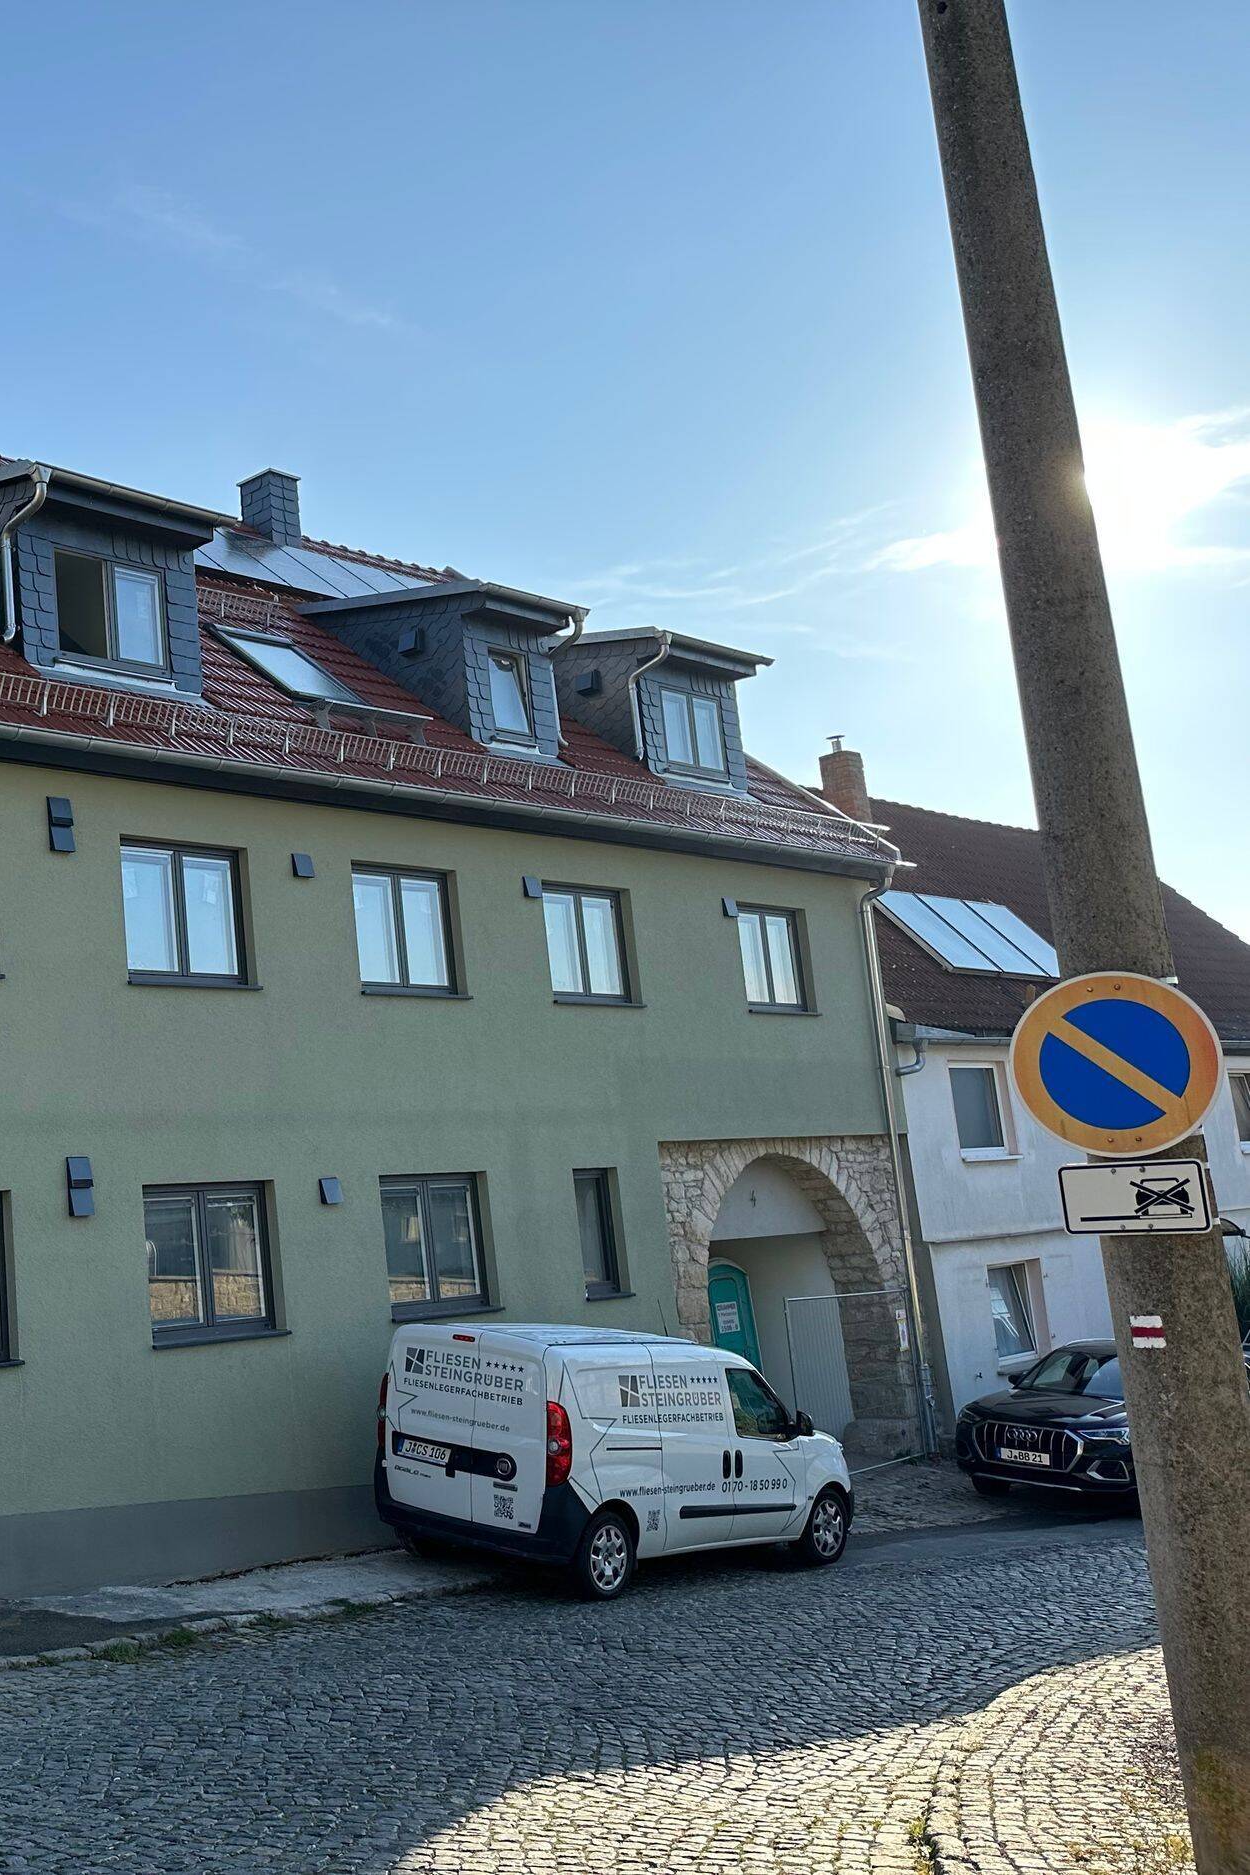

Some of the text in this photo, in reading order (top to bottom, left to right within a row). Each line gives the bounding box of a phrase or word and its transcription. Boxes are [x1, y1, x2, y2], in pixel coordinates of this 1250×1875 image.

[426, 1350, 481, 1370] FLIESEN
[425, 1364, 524, 1392] STEINGRÜBER
[639, 1374, 688, 1389] FLIESEN
[403, 1377, 523, 1406] FLIESENLEGERFACHBETRIEB
[641, 1392, 722, 1407] STEINGRÜBER
[411, 1408, 510, 1433] www.fliesen-steingrueber.de
[622, 1412, 724, 1424] FLIESENLEGERFACHBETRIEB
[416, 1444, 429, 1456] CS
[429, 1447, 447, 1461] 106
[1031, 1453, 1043, 1463] 21
[619, 1481, 716, 1498] www.fliesen-steingrueber.de
[721, 1480, 744, 1493] 0170
[759, 1479, 770, 1491] 50
